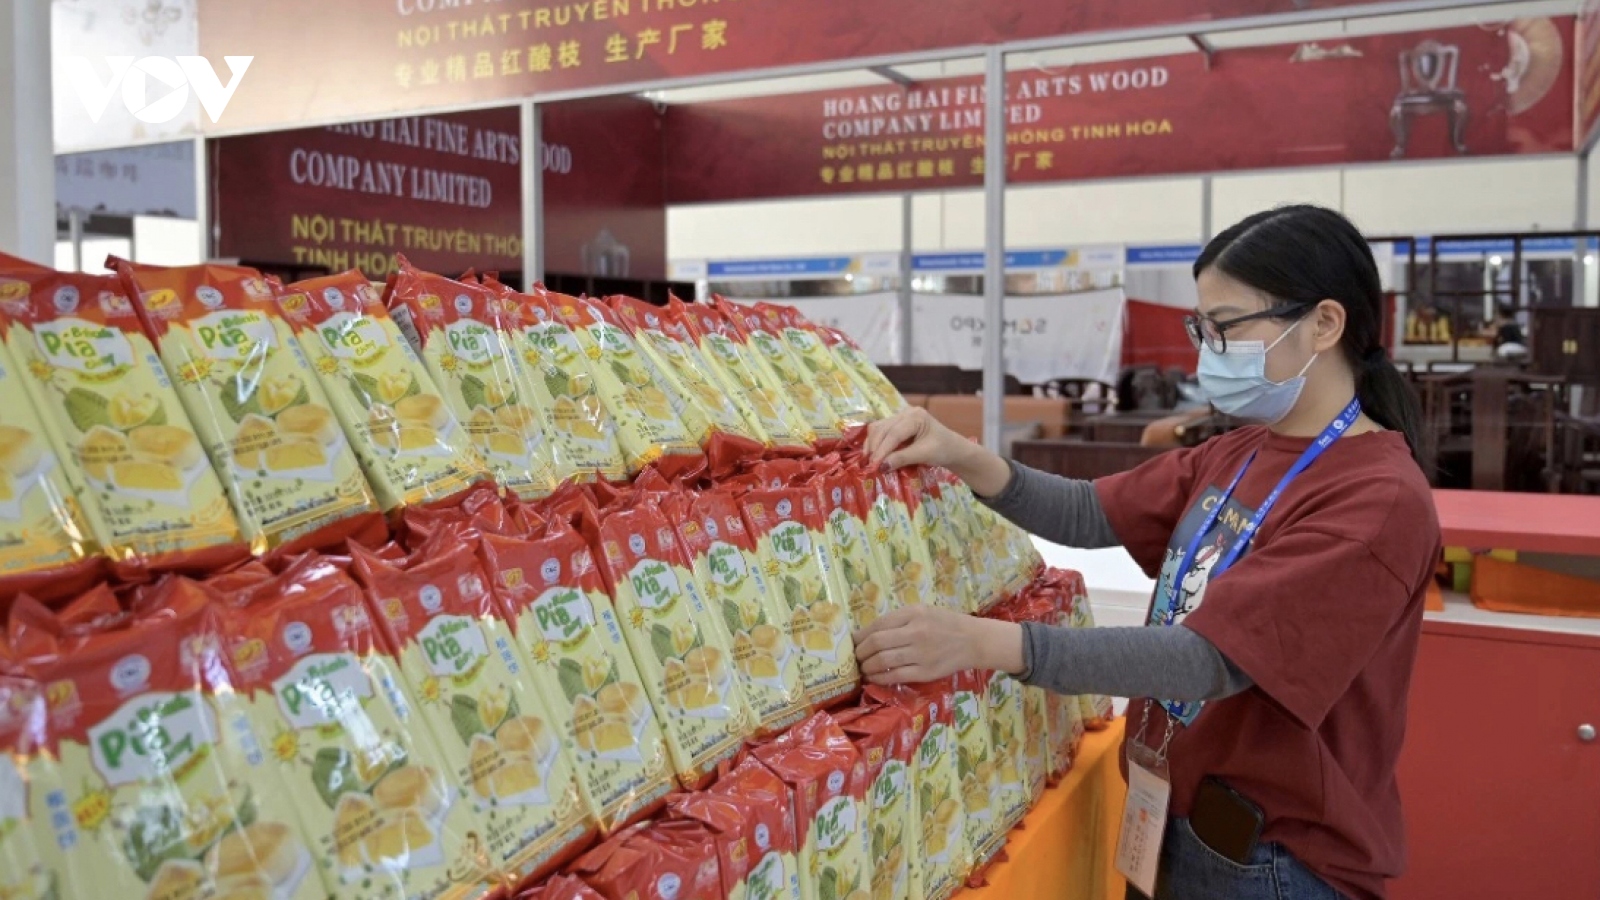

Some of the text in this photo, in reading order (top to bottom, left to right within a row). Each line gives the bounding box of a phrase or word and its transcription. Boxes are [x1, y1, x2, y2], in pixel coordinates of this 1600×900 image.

[605, 19, 728, 63] 生产厂家
[823, 93, 900, 118] HOANG
[907, 86, 949, 109] HAI
[1017, 75, 1081, 99] ARTS
[1089, 67, 1169, 91] WOOD
[424, 118, 469, 156] FINE
[473, 129, 520, 166] ARTS
[823, 112, 933, 139] COMPANY
[1071, 123, 1120, 141] TINH
[1126, 119, 1172, 136] HOA
[290, 149, 492, 208] COMPANY LIMITED
